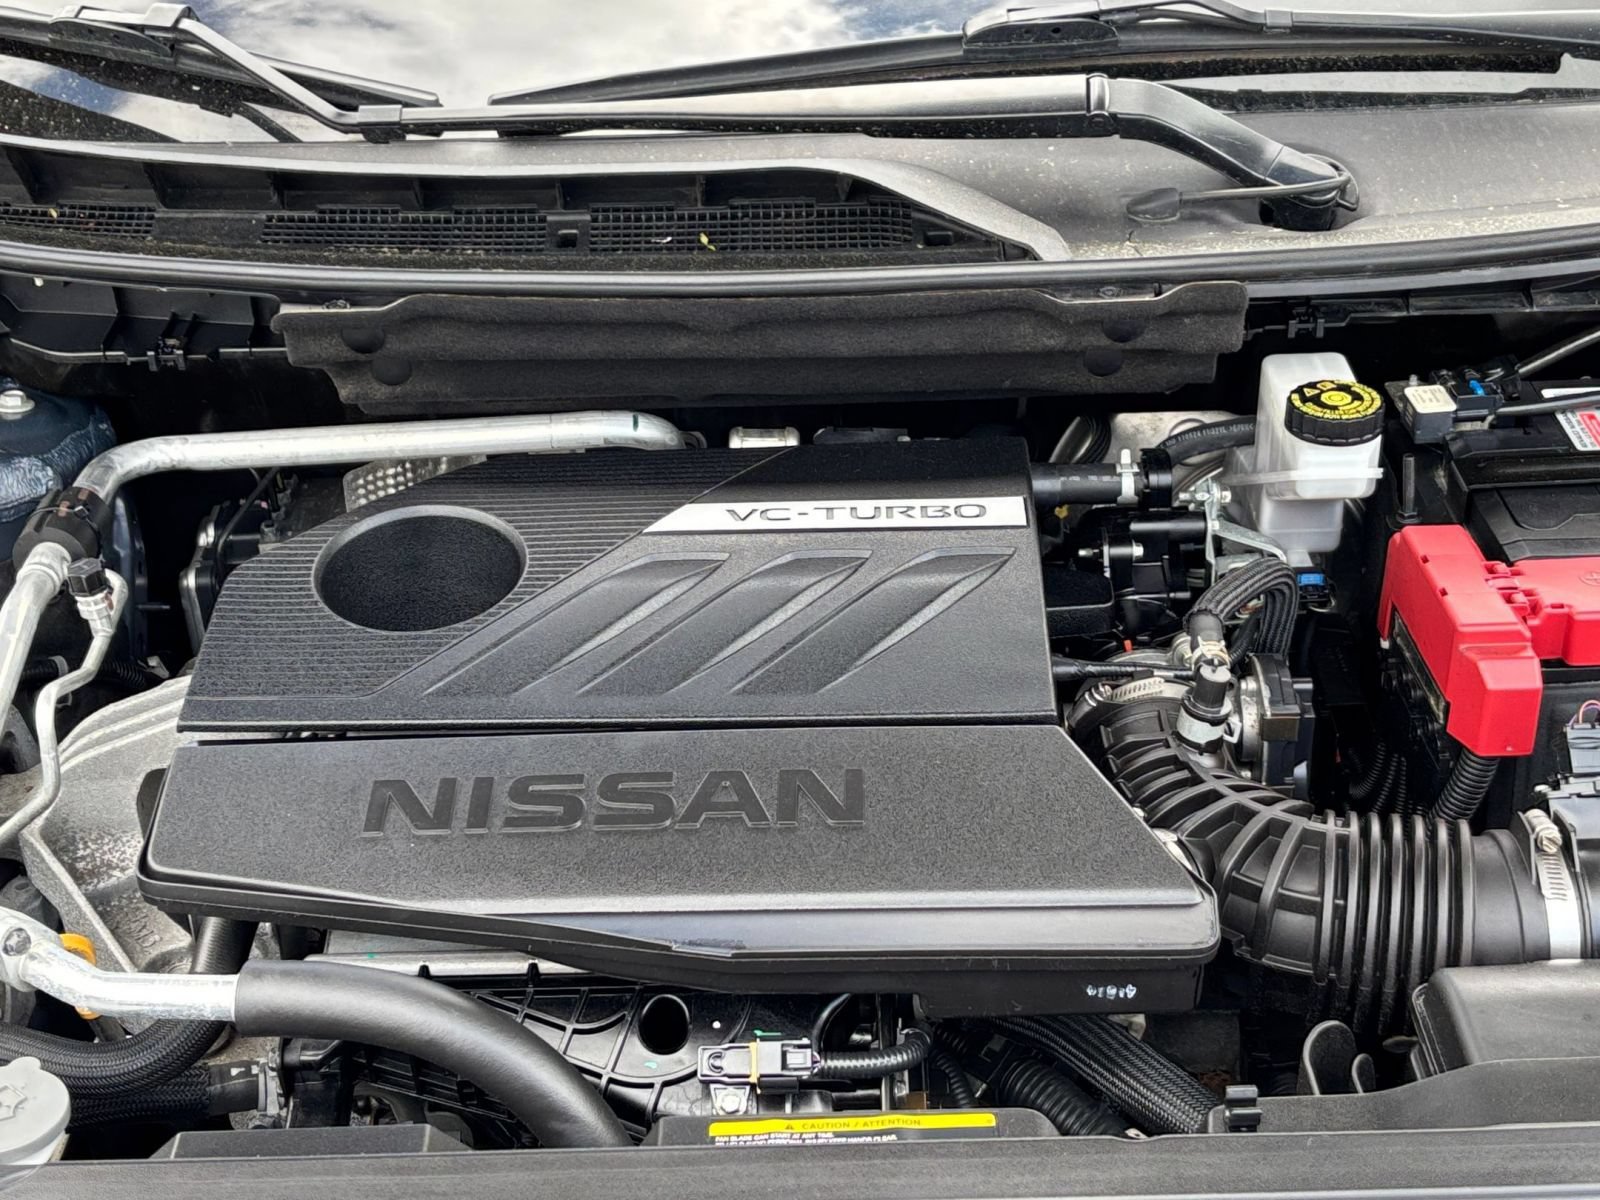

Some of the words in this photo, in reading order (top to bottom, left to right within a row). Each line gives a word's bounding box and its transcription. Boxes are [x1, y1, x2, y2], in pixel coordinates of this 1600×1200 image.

[725, 503, 987, 522] VC-TURBO
[360, 768, 865, 838] NISSAN
[801, 1122, 851, 1130] CAUTION
[862, 1119, 921, 1128] ATTENTION
